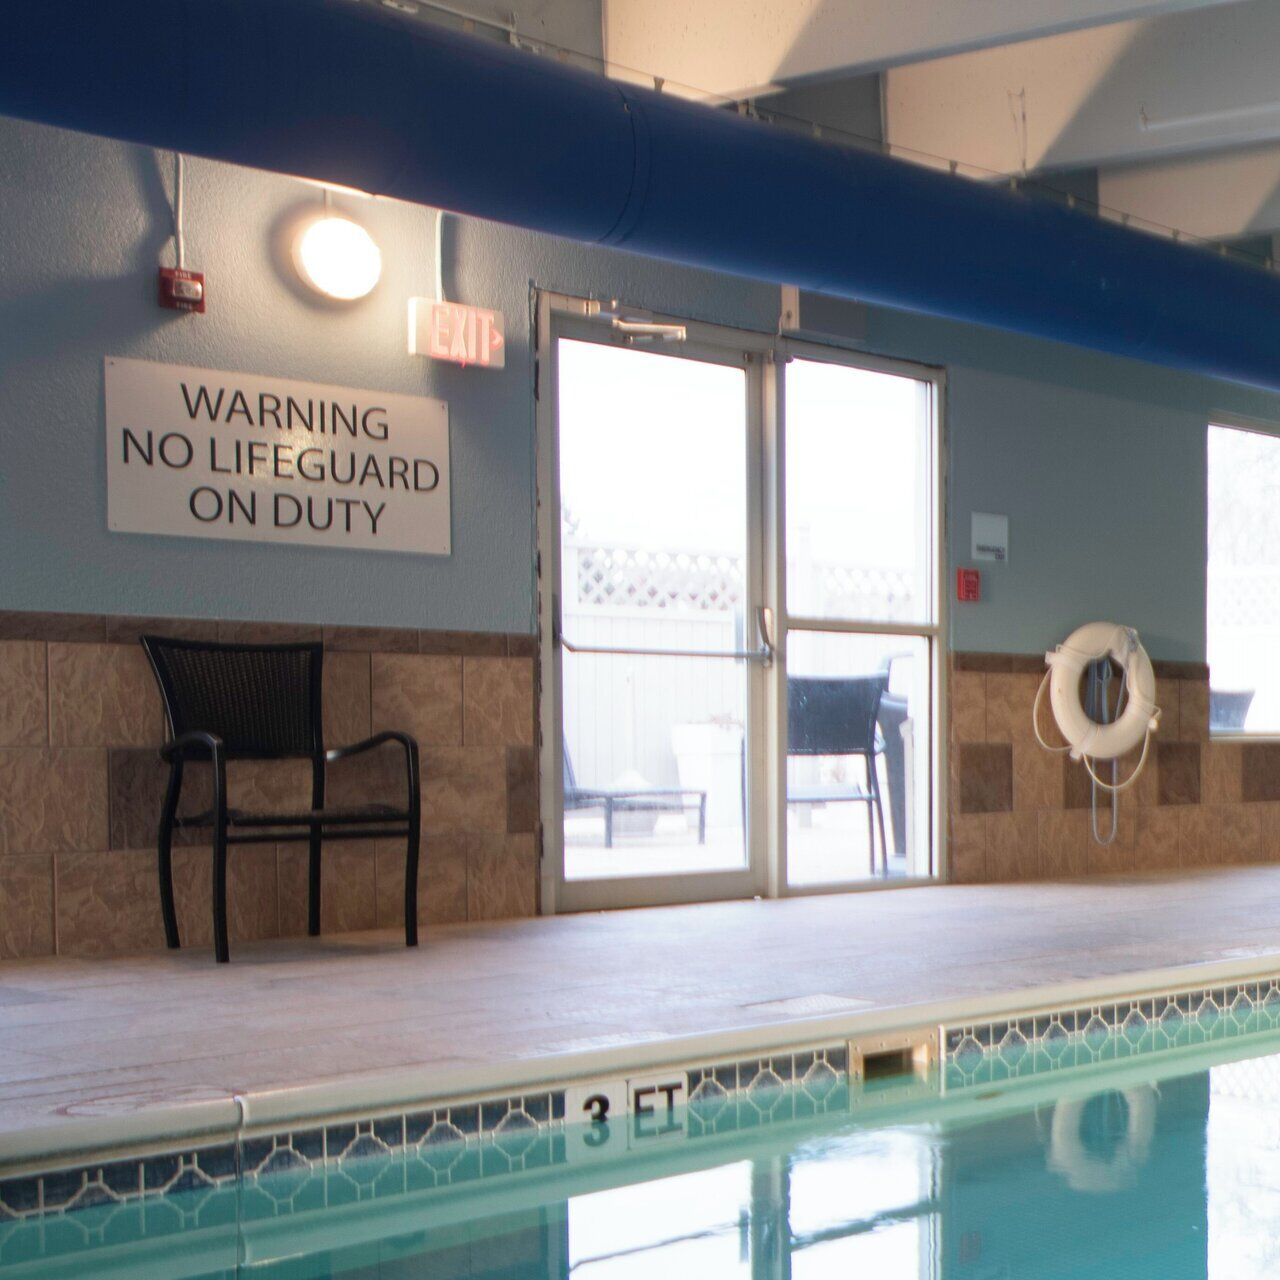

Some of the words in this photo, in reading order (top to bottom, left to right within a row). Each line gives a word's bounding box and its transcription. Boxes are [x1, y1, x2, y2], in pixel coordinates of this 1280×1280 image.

[431, 304, 494, 366] EXIT
[180, 382, 389, 441] WARNING
[121, 428, 194, 469] NO
[210, 436, 440, 492] LIFEGUARD
[189, 486, 256, 526] ON
[274, 493, 386, 535] DUTY
